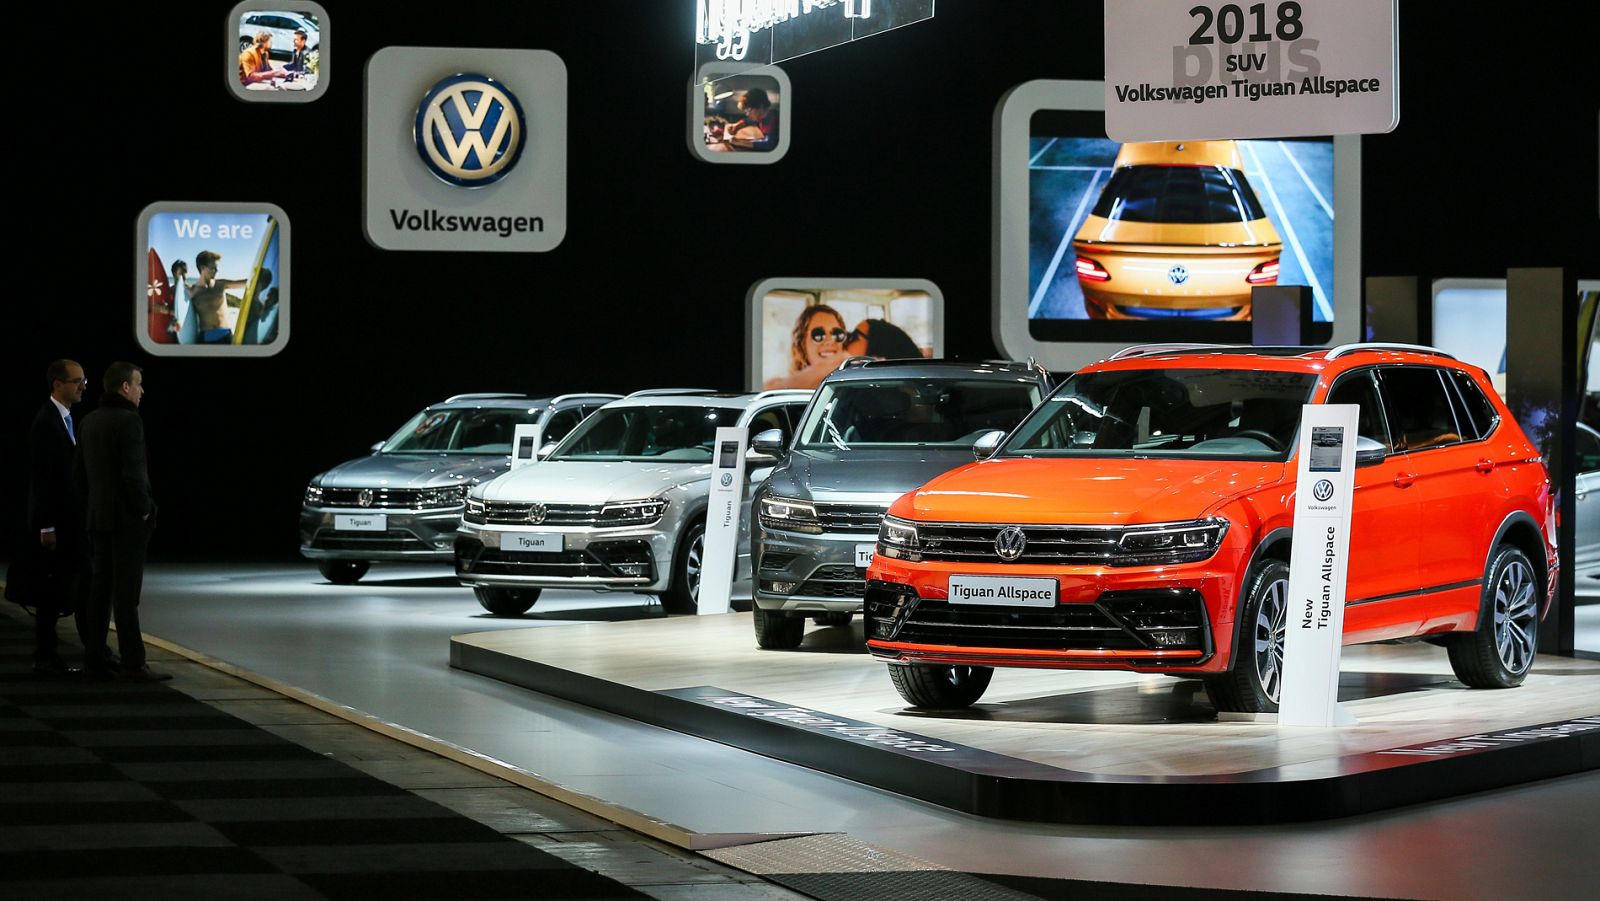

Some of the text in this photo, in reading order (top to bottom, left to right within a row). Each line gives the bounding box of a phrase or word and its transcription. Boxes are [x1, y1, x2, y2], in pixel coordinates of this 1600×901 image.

[1188, 1, 1304, 46] 2018
[1226, 53, 1267, 72] SUV
[1115, 76, 1381, 104] Volkswagen Tiguan Allspace
[174, 219, 253, 240] We are
[390, 209, 544, 238] Volkswagen
[350, 518, 372, 527] Tiguan
[723, 500, 732, 528] Tiguan
[518, 537, 545, 546] Tiguan
[1318, 526, 1335, 629] Tiguan Allspace
[952, 584, 1052, 601] Tiguan Allspace
[1302, 599, 1314, 629] New
